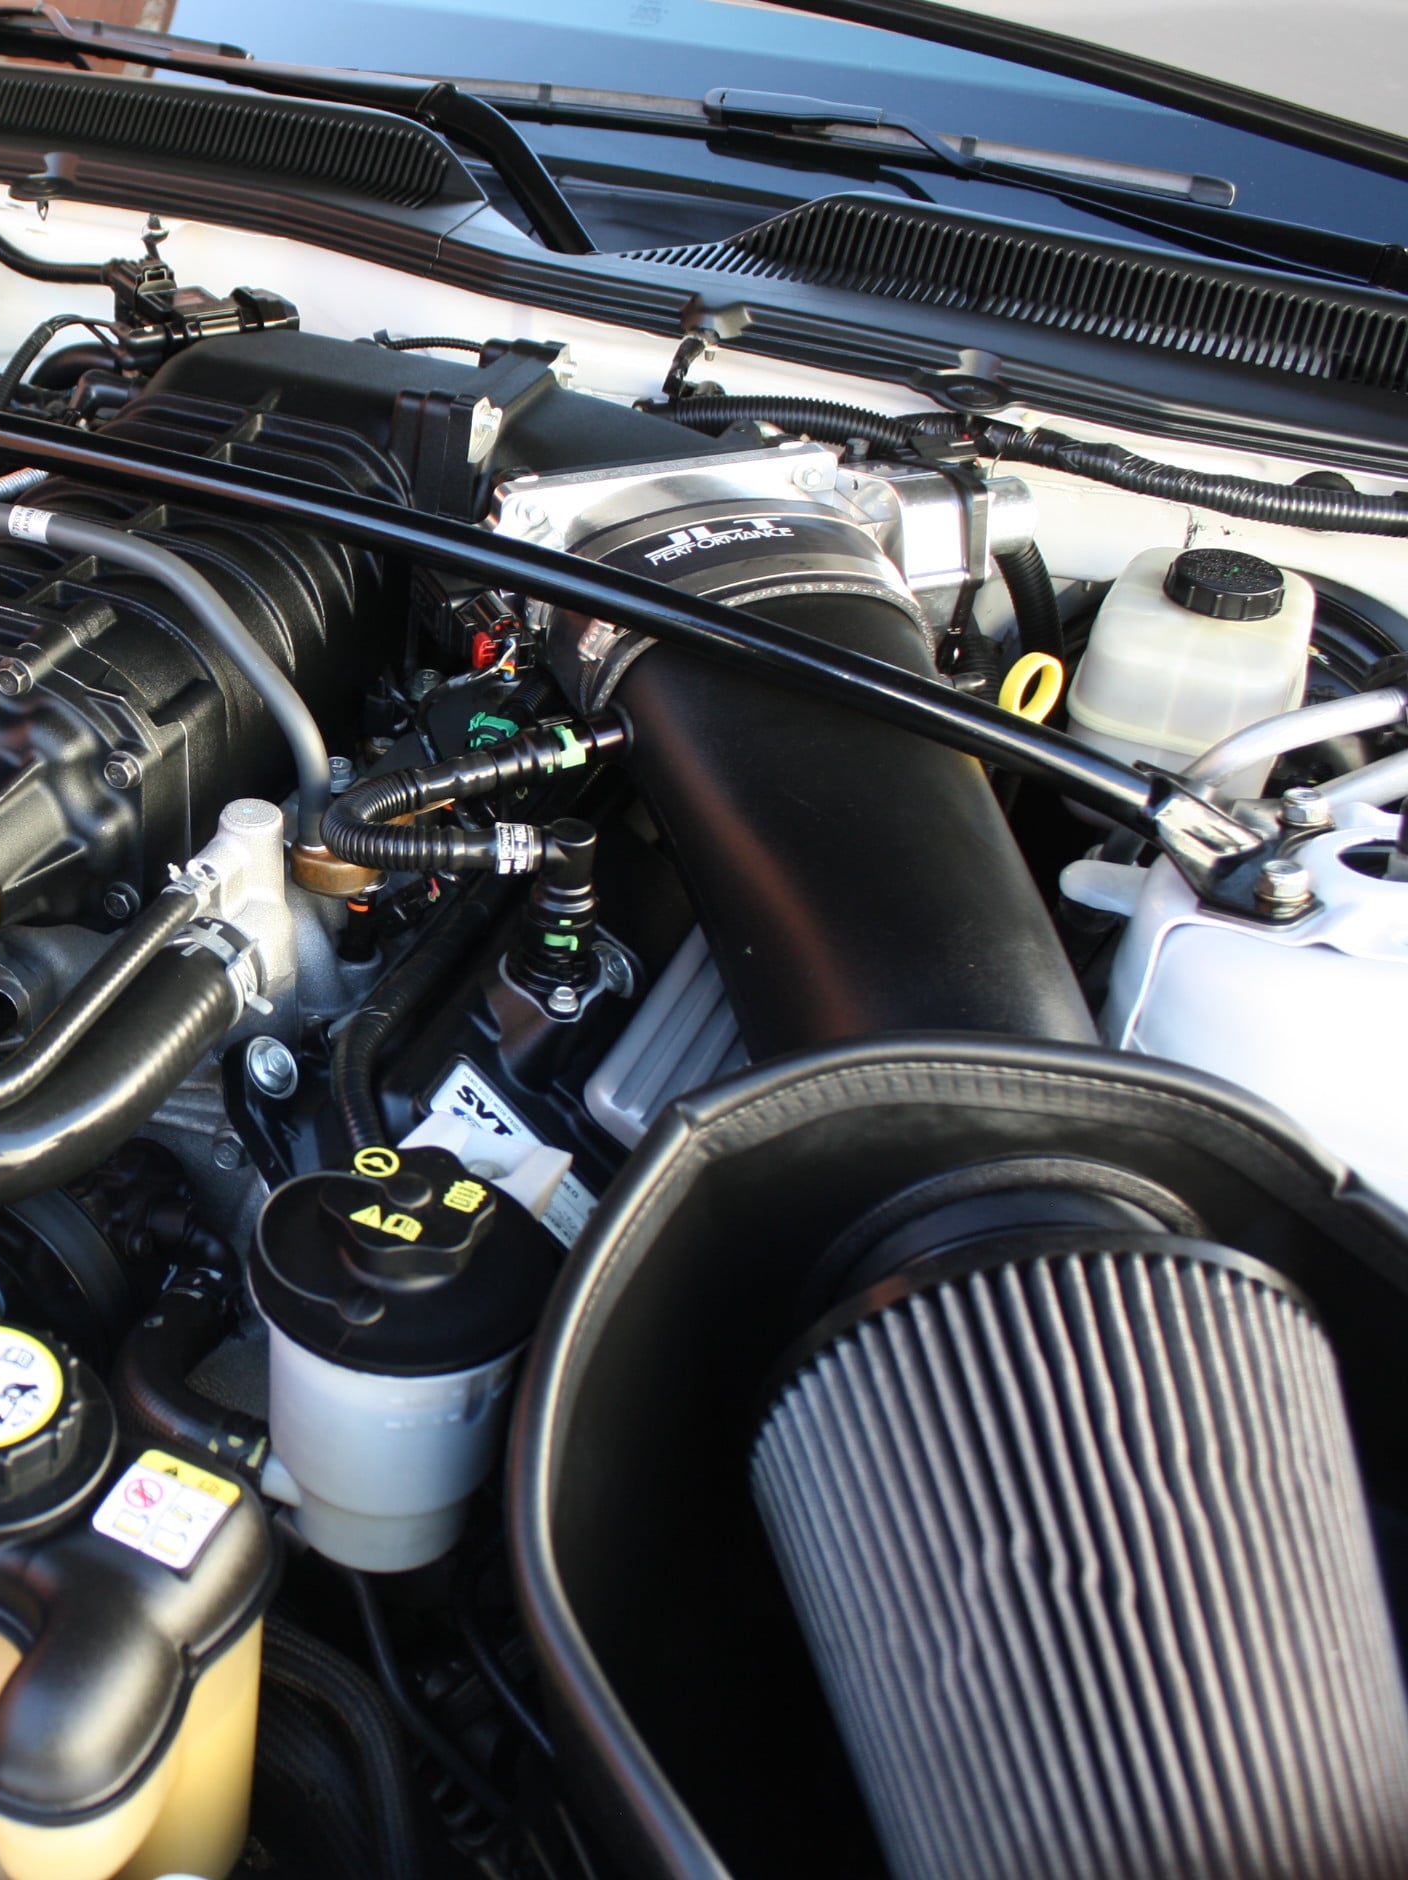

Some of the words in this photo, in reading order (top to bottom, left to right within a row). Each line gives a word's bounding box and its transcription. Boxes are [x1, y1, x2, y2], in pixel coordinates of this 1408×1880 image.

[644, 517, 782, 558] JLT
[649, 527, 795, 566] PERFORMANCE
[455, 1084, 513, 1136] SVT
